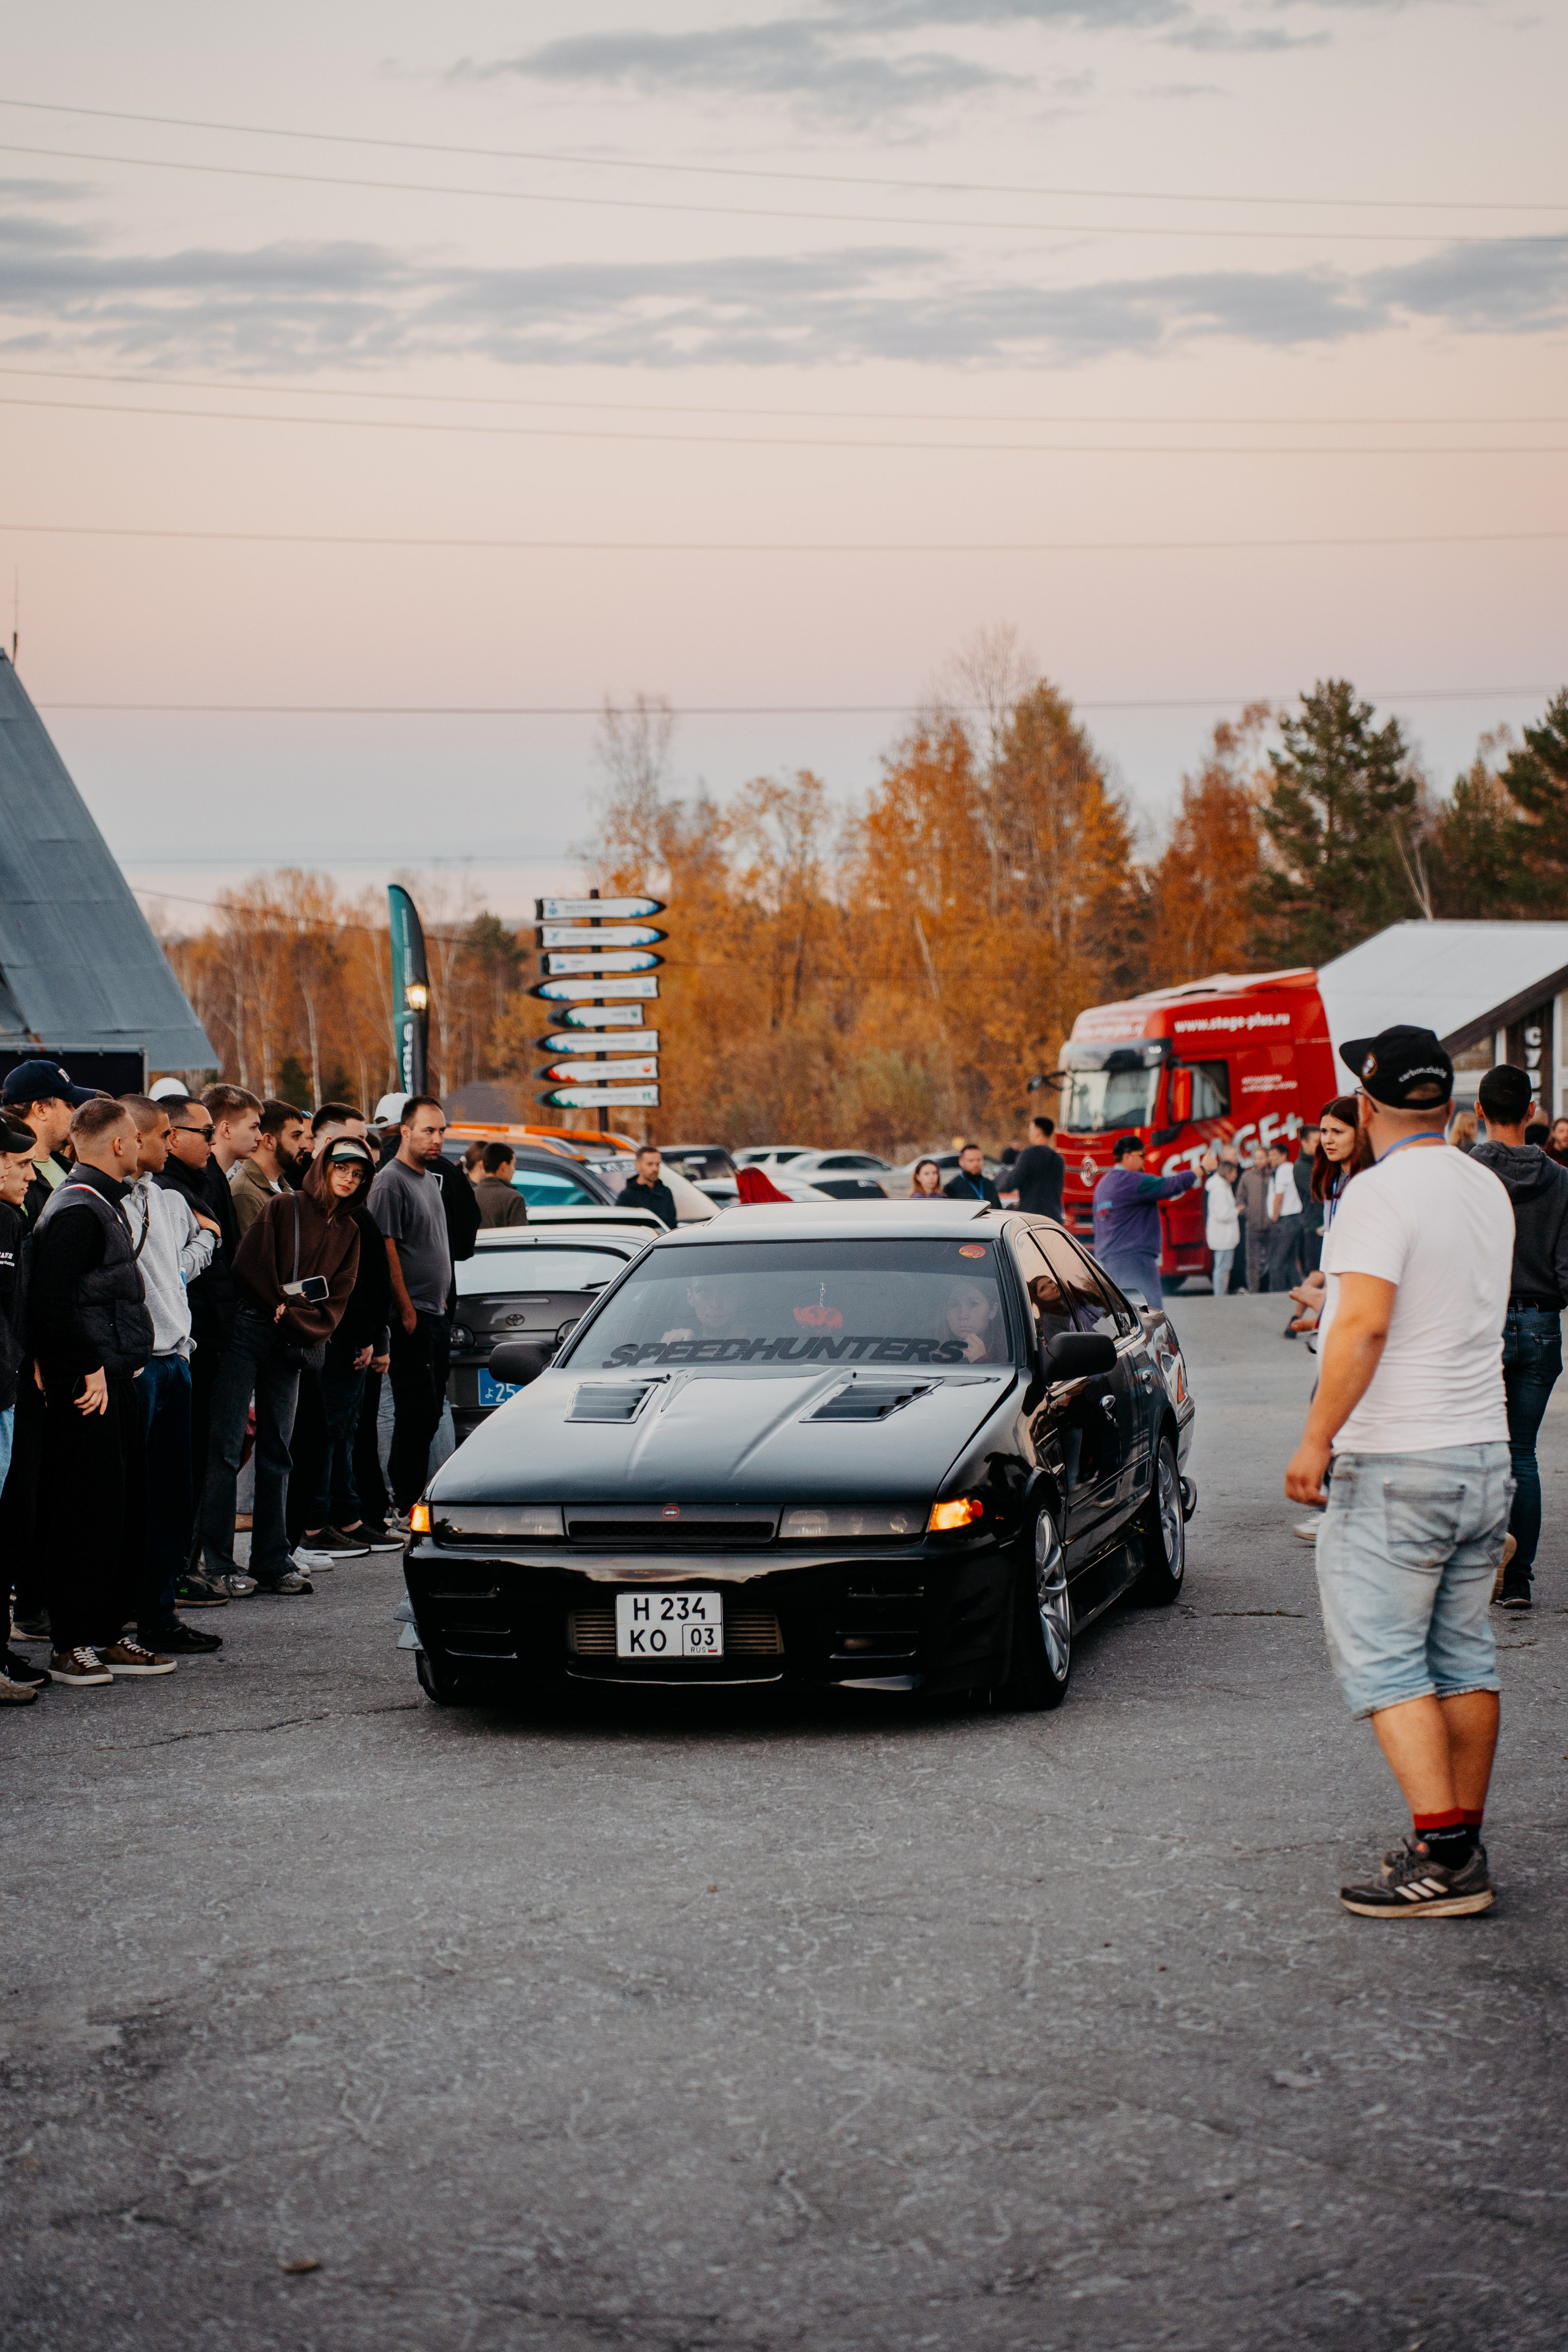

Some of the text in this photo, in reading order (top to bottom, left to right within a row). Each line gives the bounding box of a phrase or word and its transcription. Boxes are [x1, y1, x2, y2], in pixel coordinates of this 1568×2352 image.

[602, 1336, 968, 1369] SPEEDHUNTERS
[485, 1387, 493, 1398] よ
[661, 1597, 706, 1621] 234
[691, 1628, 714, 1646] 03
